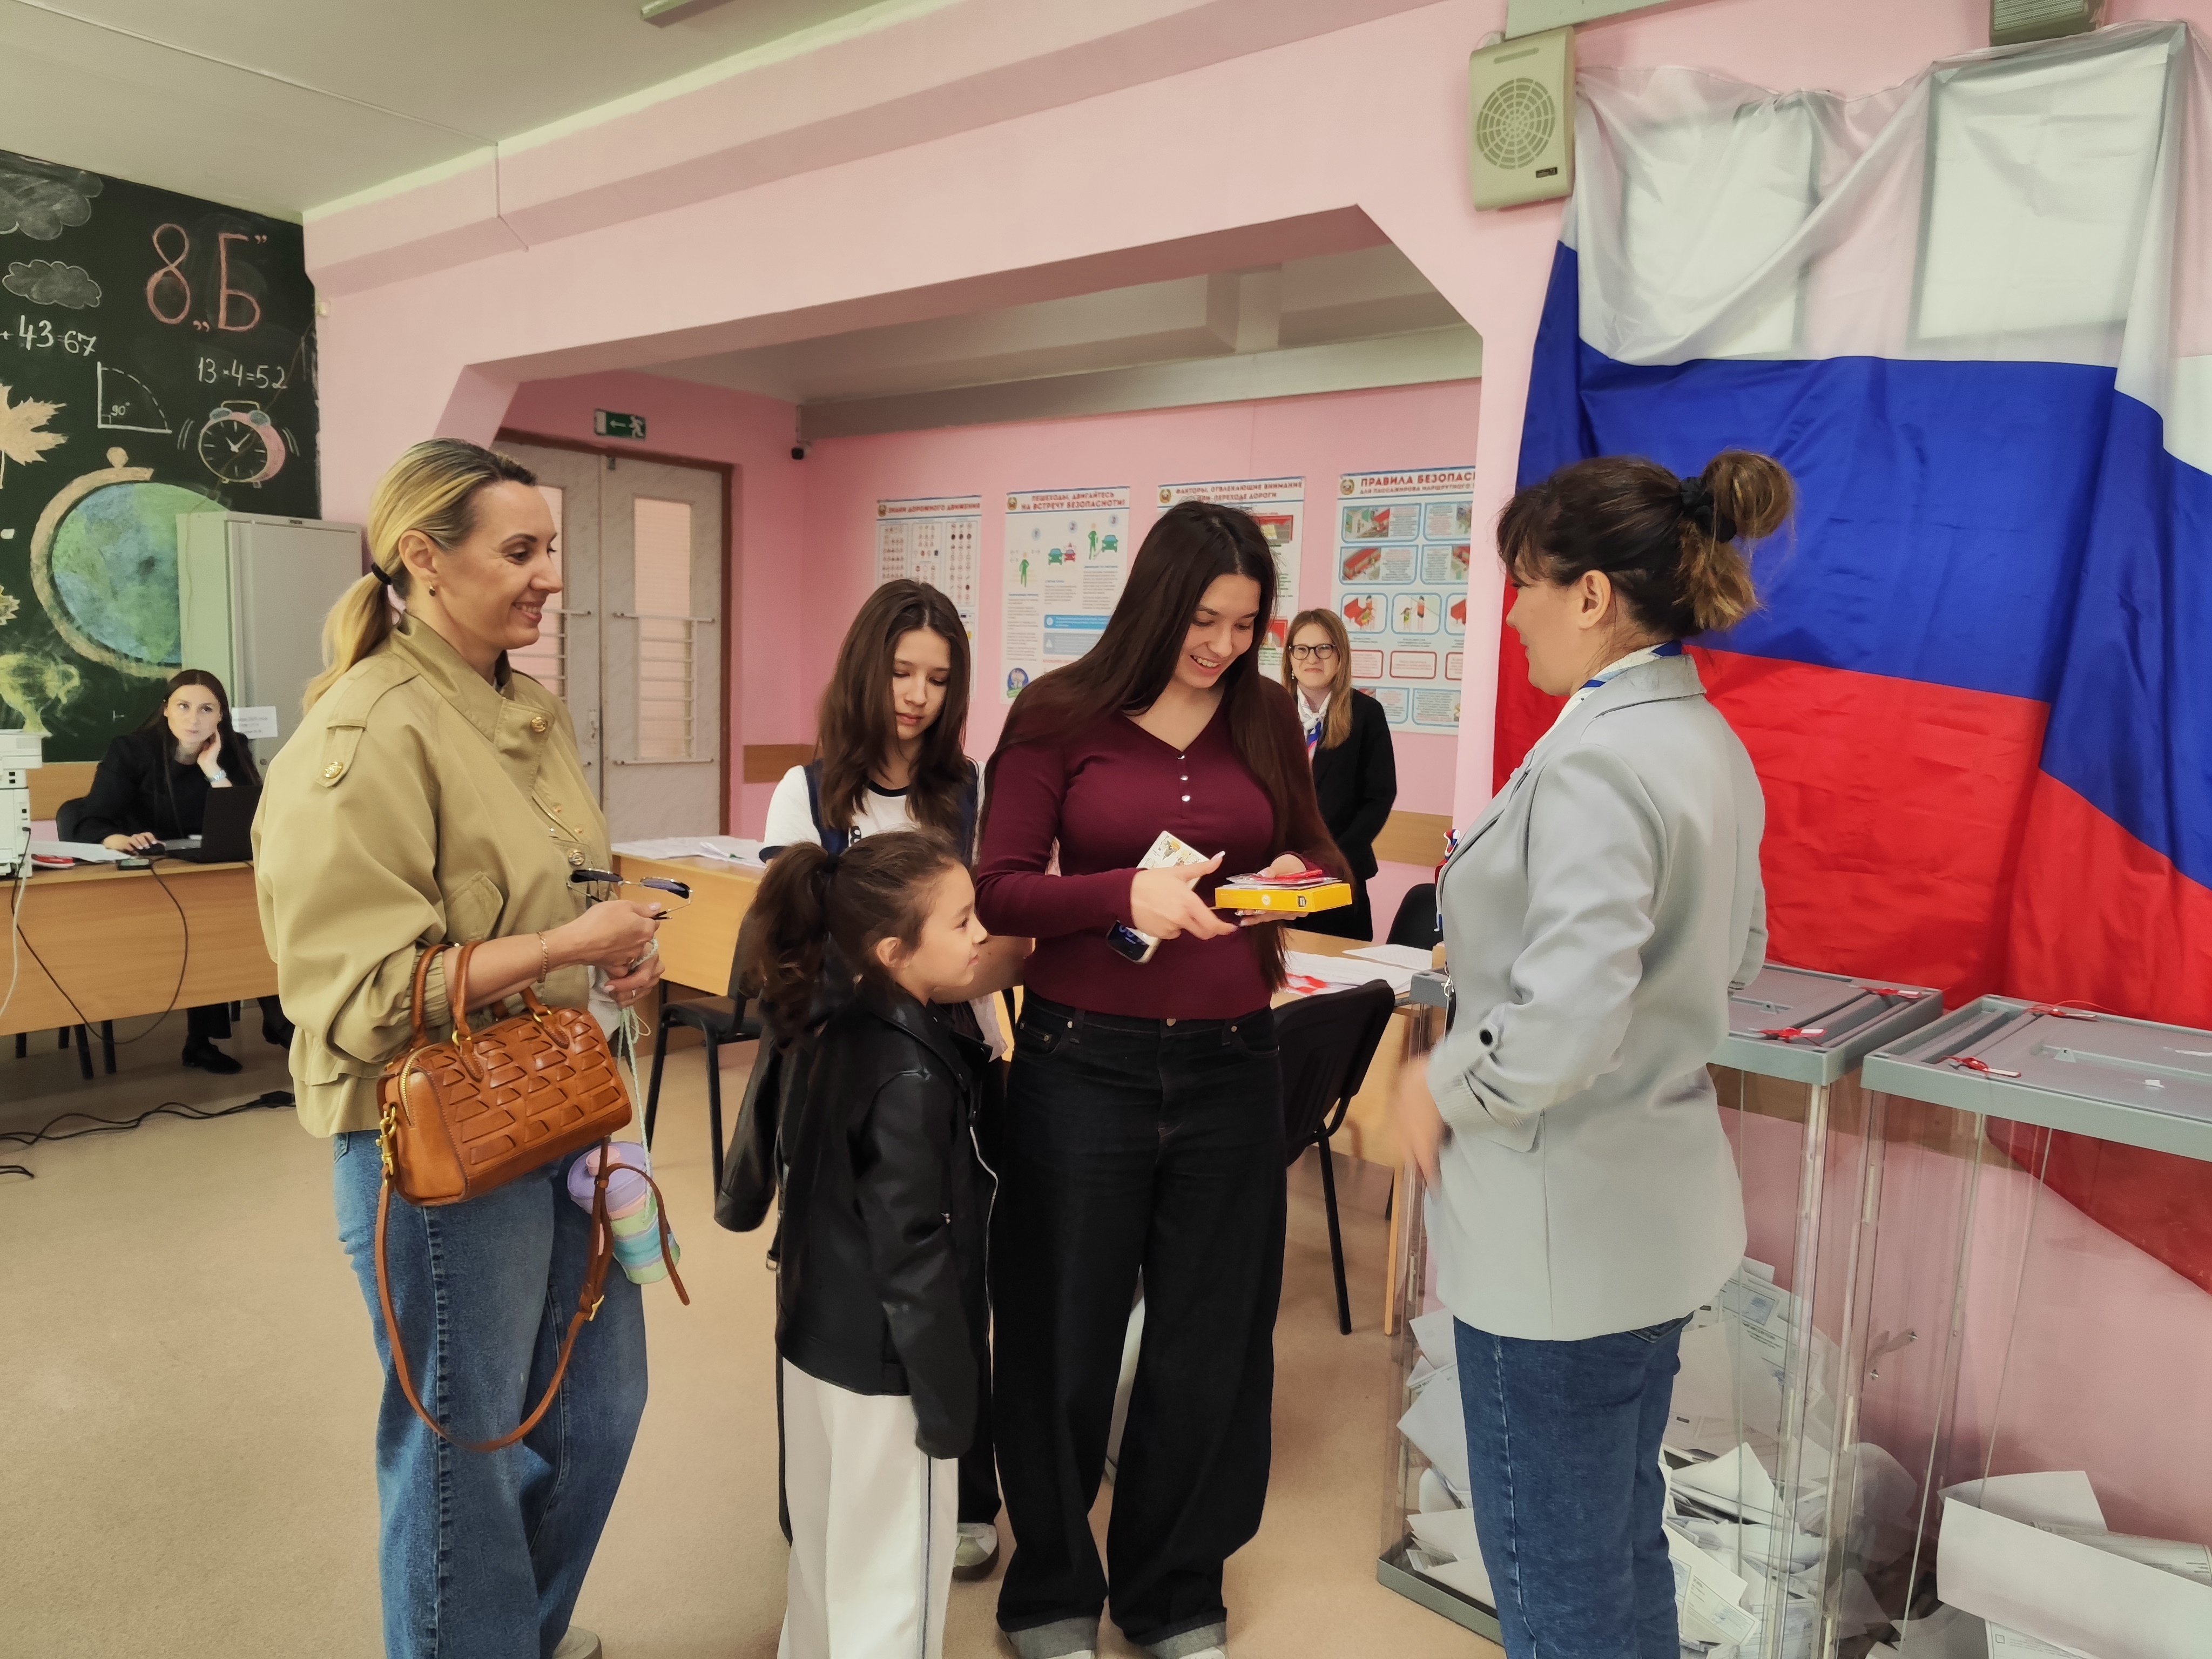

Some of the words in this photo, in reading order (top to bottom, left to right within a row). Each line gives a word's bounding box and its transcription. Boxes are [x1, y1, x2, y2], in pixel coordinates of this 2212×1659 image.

[1360, 476, 1413, 487] ПРАВИЛА
[1417, 472, 1475, 484] БЕЗОПАС
[1211, 484, 1262, 493] ОТВЛЕКАЮЩИЕ
[1264, 482, 1302, 490] ВНИМАНИЕ
[1072, 491, 1115, 500] ДВИГАЙТЕСЬ
[1214, 494, 1247, 502] ПЕРЕХОДЕ
[1033, 502, 1064, 510] ВСТРЕЧУ
